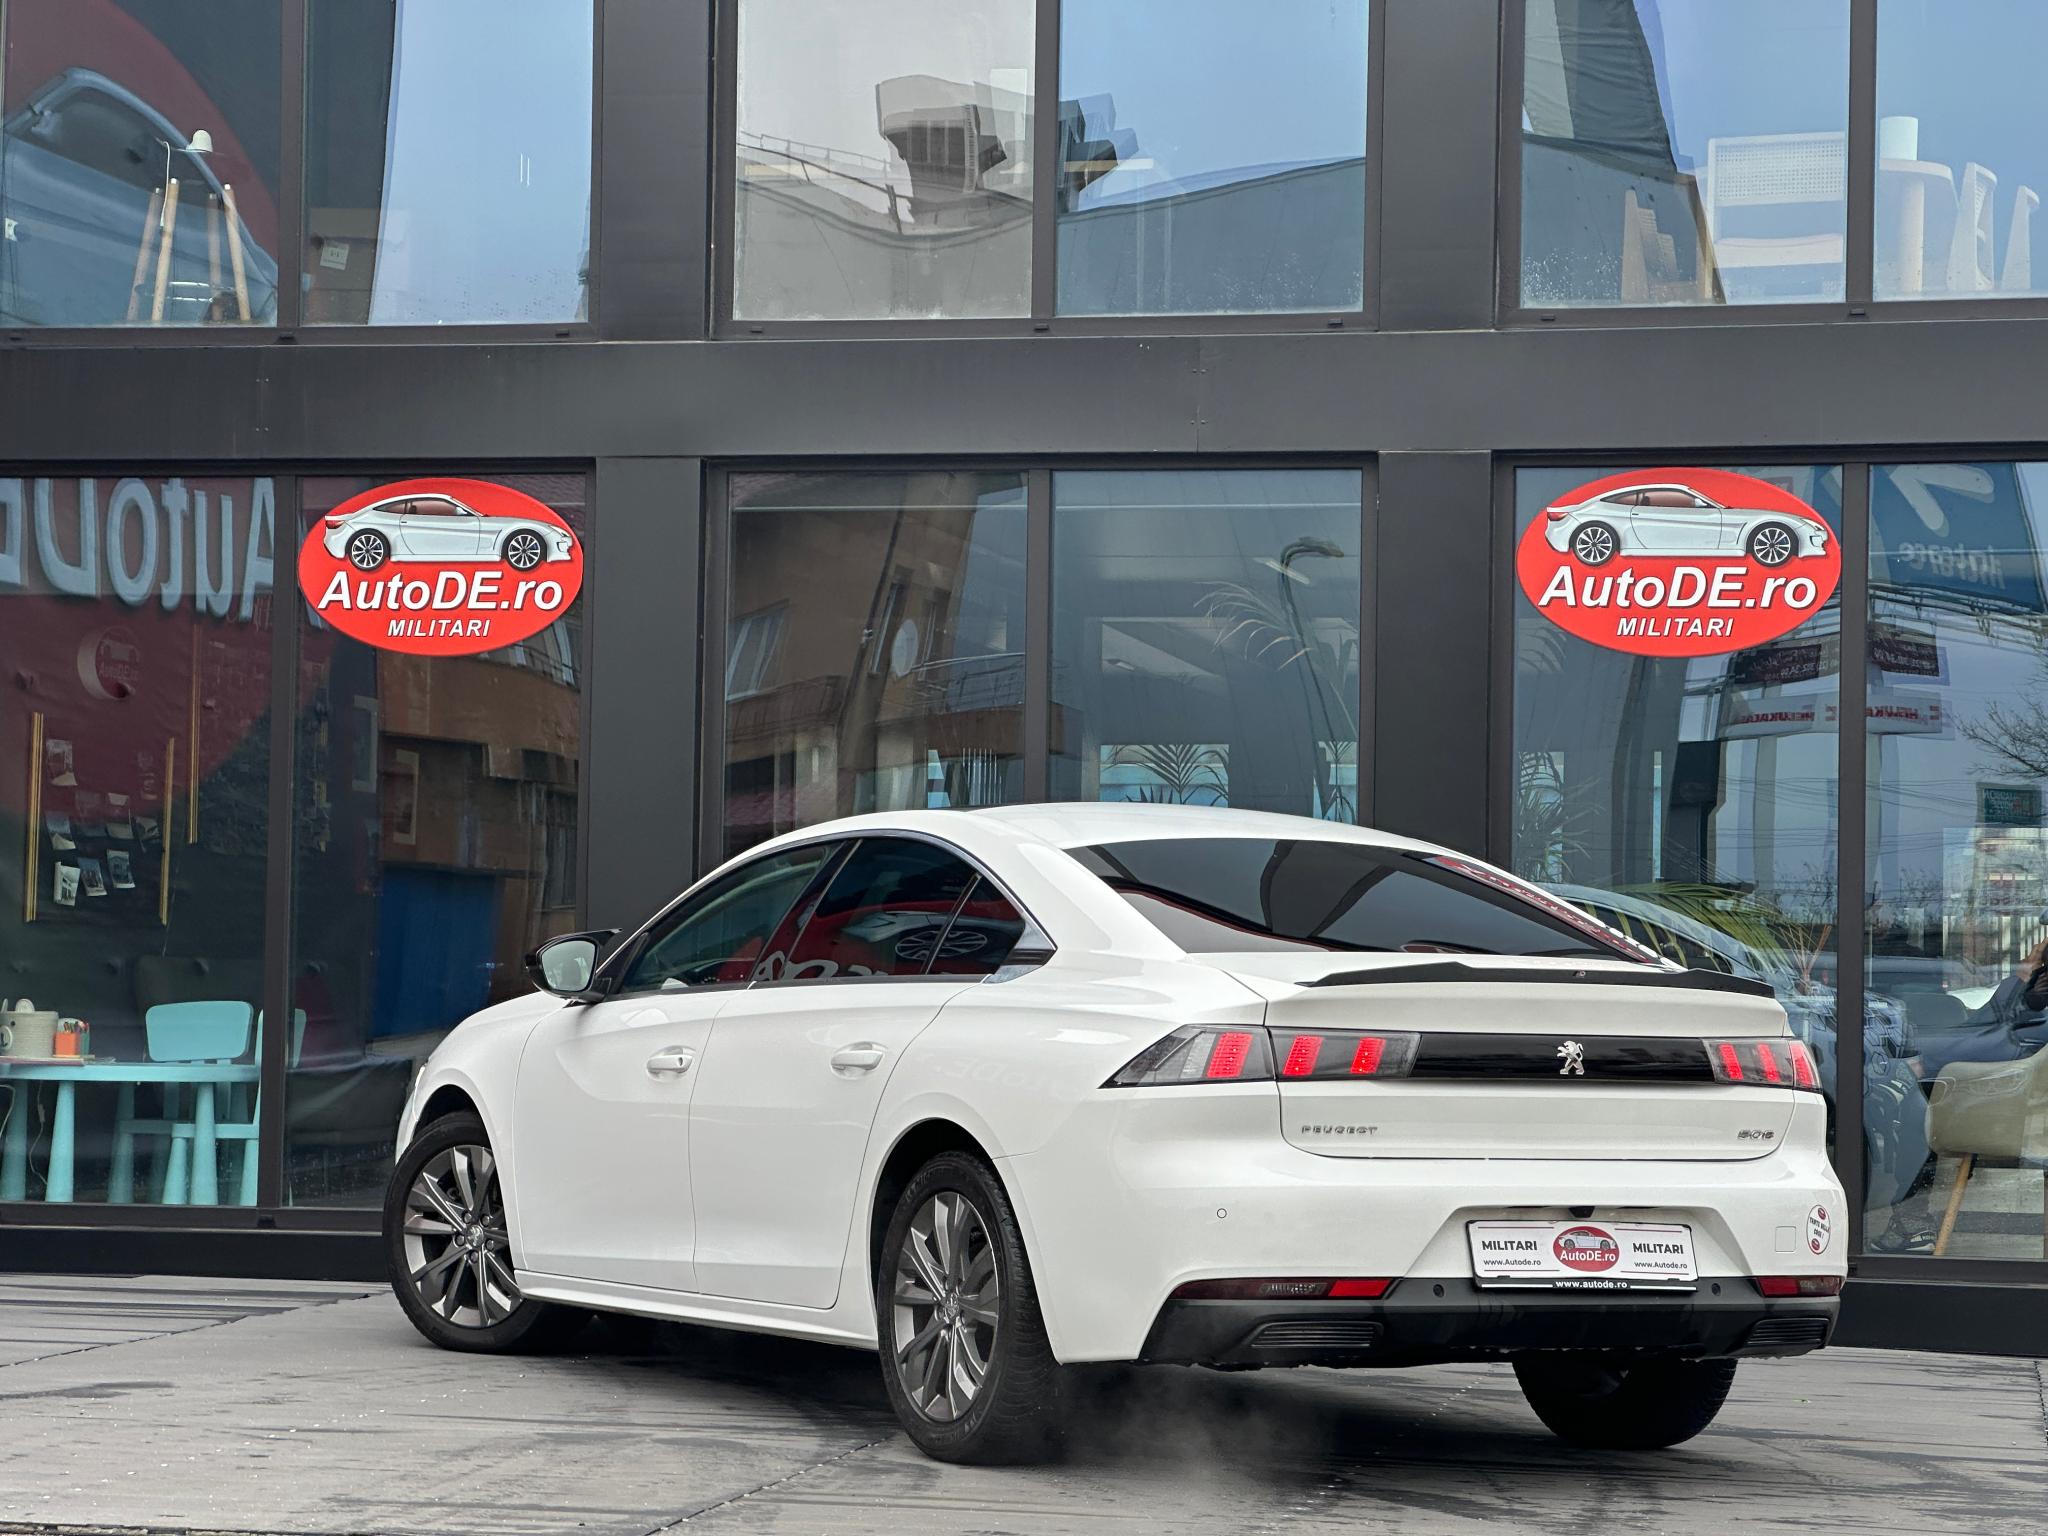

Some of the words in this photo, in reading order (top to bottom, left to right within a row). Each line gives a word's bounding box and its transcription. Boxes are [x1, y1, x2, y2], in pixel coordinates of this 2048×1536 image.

[317, 570, 563, 611] AutoDE.ro
[1538, 565, 1818, 609] AutoDE.ro
[387, 619, 491, 638] MILITARI
[1616, 617, 1735, 638] MILITARI
[1482, 1240, 1538, 1251] MILITARI
[1632, 1243, 1684, 1255] MILITARI
[1483, 1258, 1542, 1267] www.Autode.ro
[1559, 1250, 1617, 1263] AutoDE.ro
[1634, 1261, 1688, 1270] www.Autode.ro
[1555, 1279, 1629, 1289] www.autode.ro
